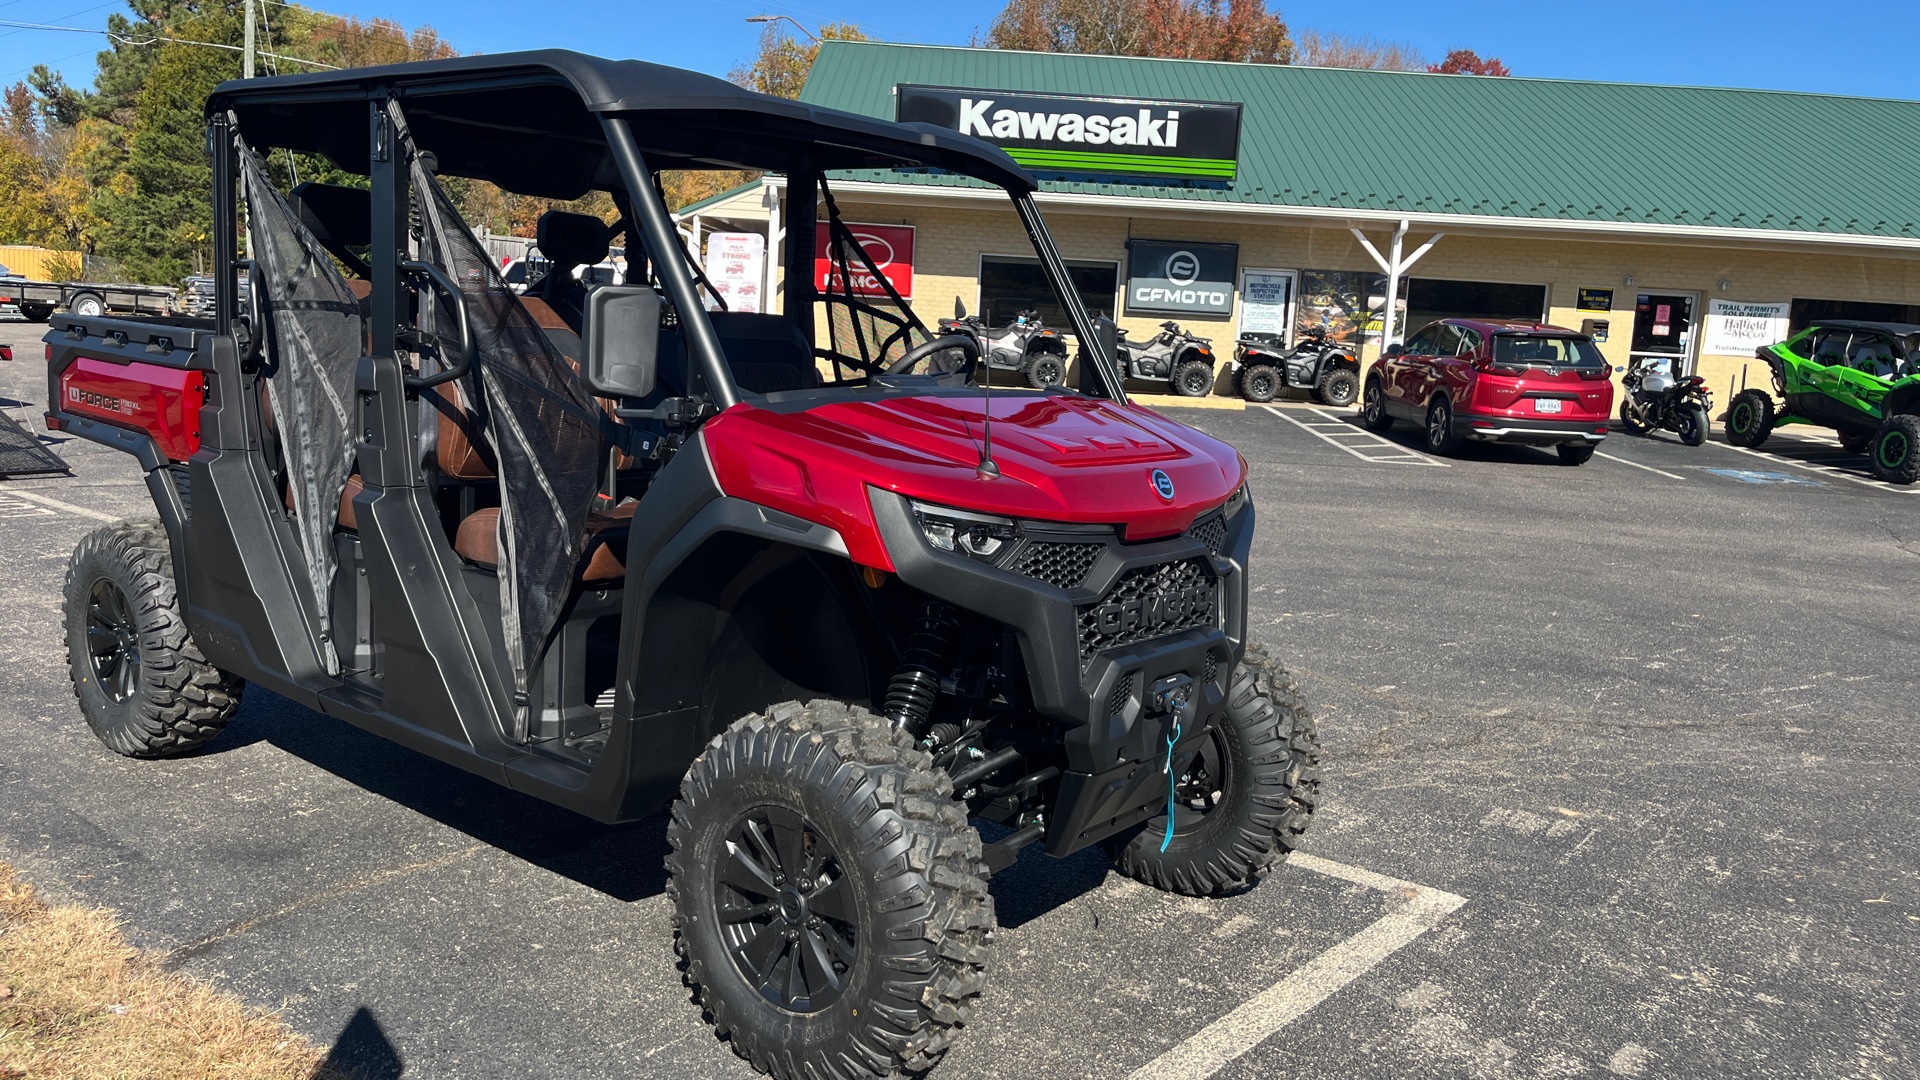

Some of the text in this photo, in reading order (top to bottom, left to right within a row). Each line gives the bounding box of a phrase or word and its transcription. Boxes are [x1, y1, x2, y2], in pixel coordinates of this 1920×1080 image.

[959, 98, 1180, 148] Kawasaki
[1135, 287, 1225, 306] CFMOTO
[1743, 305, 1781, 314] PERMITS
[1724, 318, 1768, 331] Hatfield
[69, 386, 120, 413] UFORCE
[1099, 583, 1211, 635] CFMOTO
